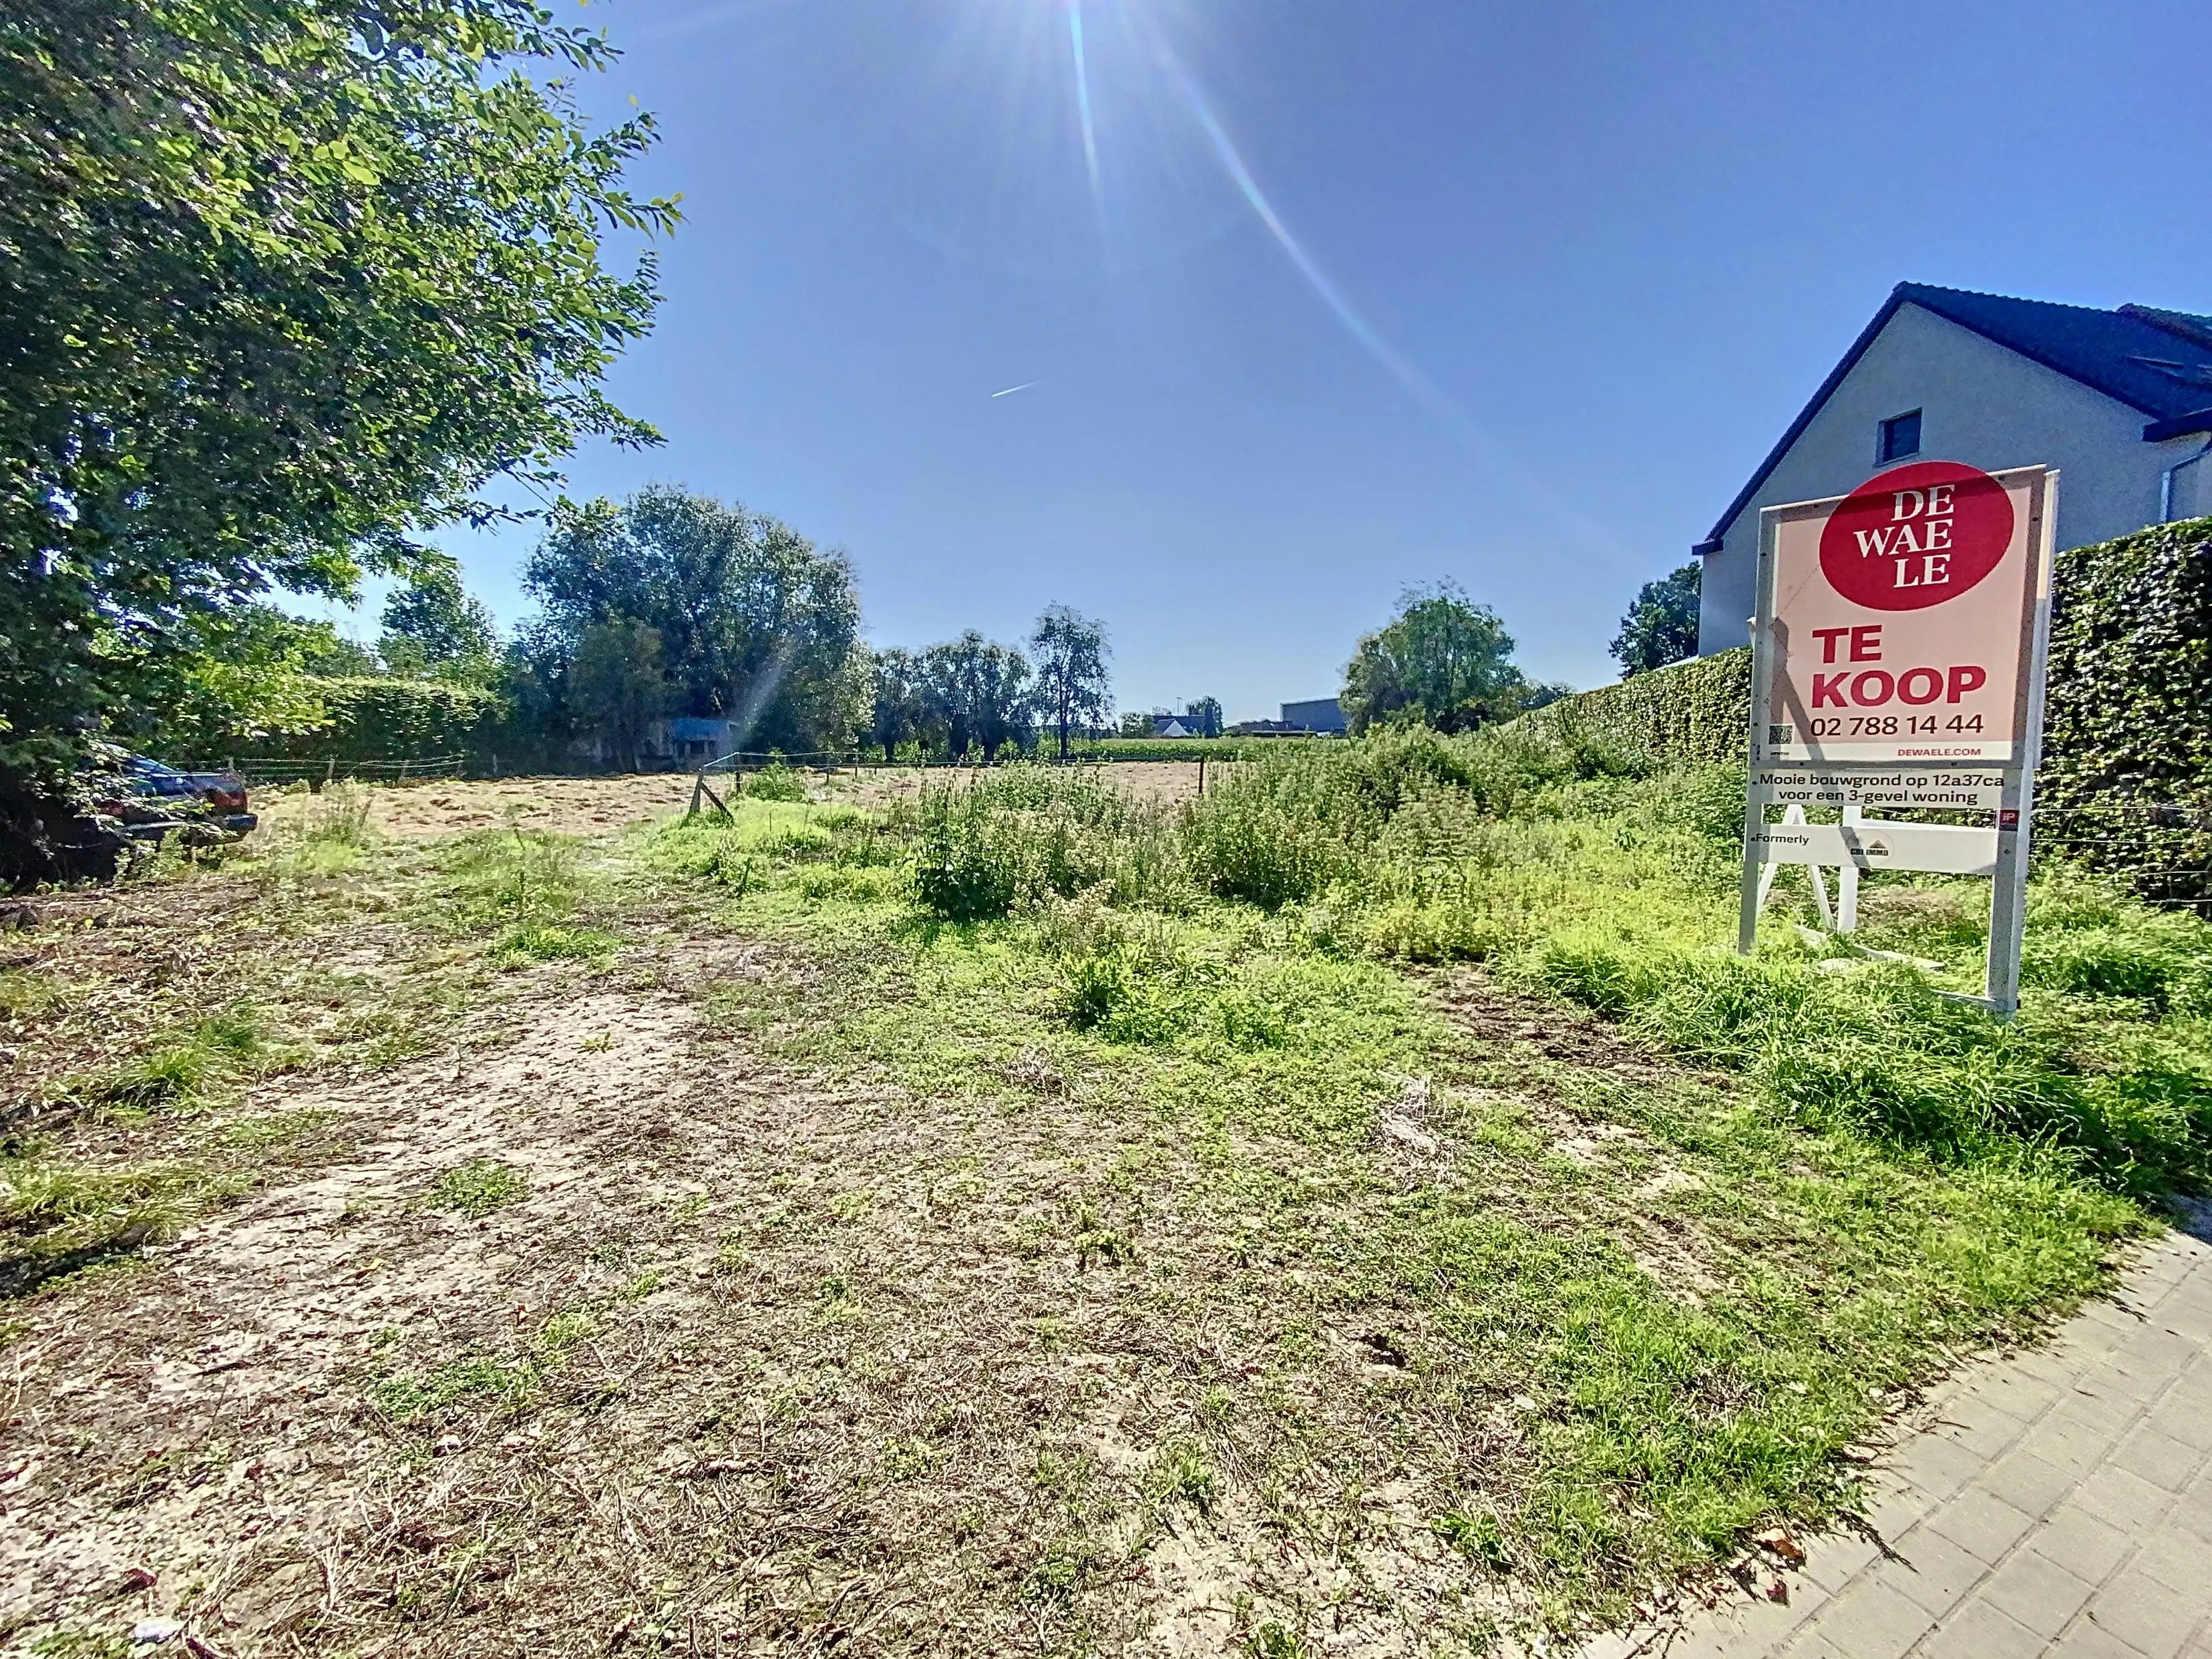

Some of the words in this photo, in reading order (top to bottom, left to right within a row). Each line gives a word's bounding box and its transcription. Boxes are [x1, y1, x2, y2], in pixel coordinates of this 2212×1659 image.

[1891, 484, 1955, 522] DE
[1853, 518, 1953, 558] WAE
[1893, 554, 1950, 588] LE
[1811, 624, 1883, 664] TE
[1811, 665, 1987, 709] KOOP
[1809, 717, 1841, 737] 02
[1849, 715, 1899, 736] 788
[1906, 715, 1938, 735] 14
[1945, 713, 1984, 735] 44
[1897, 748, 1982, 757] DEWAELE.COM
[1759, 773, 1806, 785] Mooie
[1809, 773, 1901, 789] bouwgrond
[1905, 777, 1928, 789] op
[1932, 774, 2005, 787] 12a37ca
[1778, 791, 1813, 800] voor
[1816, 791, 1844, 801] een
[1848, 789, 1908, 804] 3-gevel
[1911, 790, 1978, 806] woning
[1755, 833, 1810, 846] Formerly
